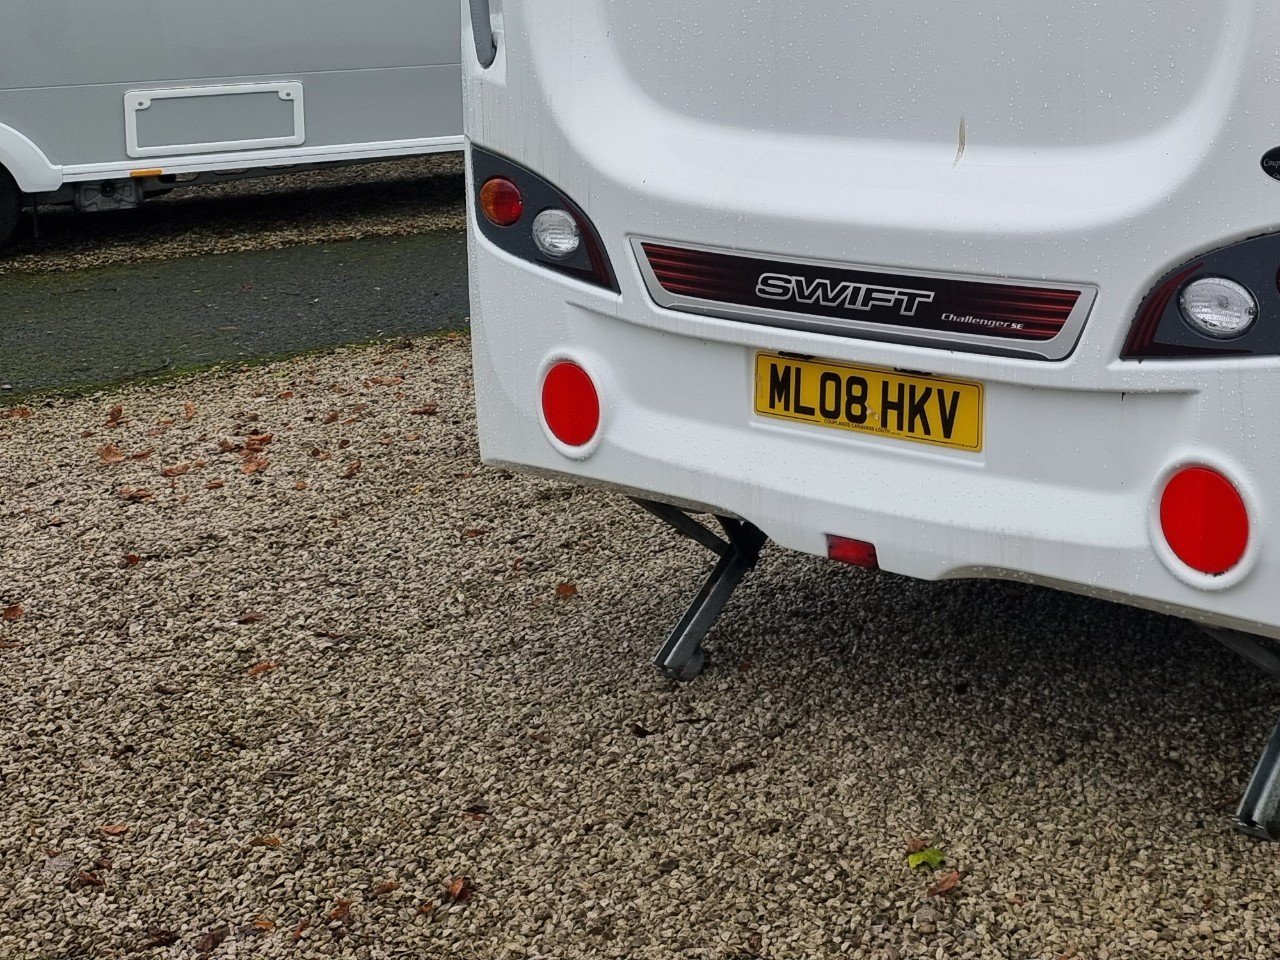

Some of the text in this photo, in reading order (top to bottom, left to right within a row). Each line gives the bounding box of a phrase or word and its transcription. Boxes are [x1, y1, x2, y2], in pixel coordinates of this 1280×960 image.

[756, 272, 935, 316] SWIFT
[941, 312, 1024, 330] Challenger SE
[769, 362, 960, 439] ML08 HKV
